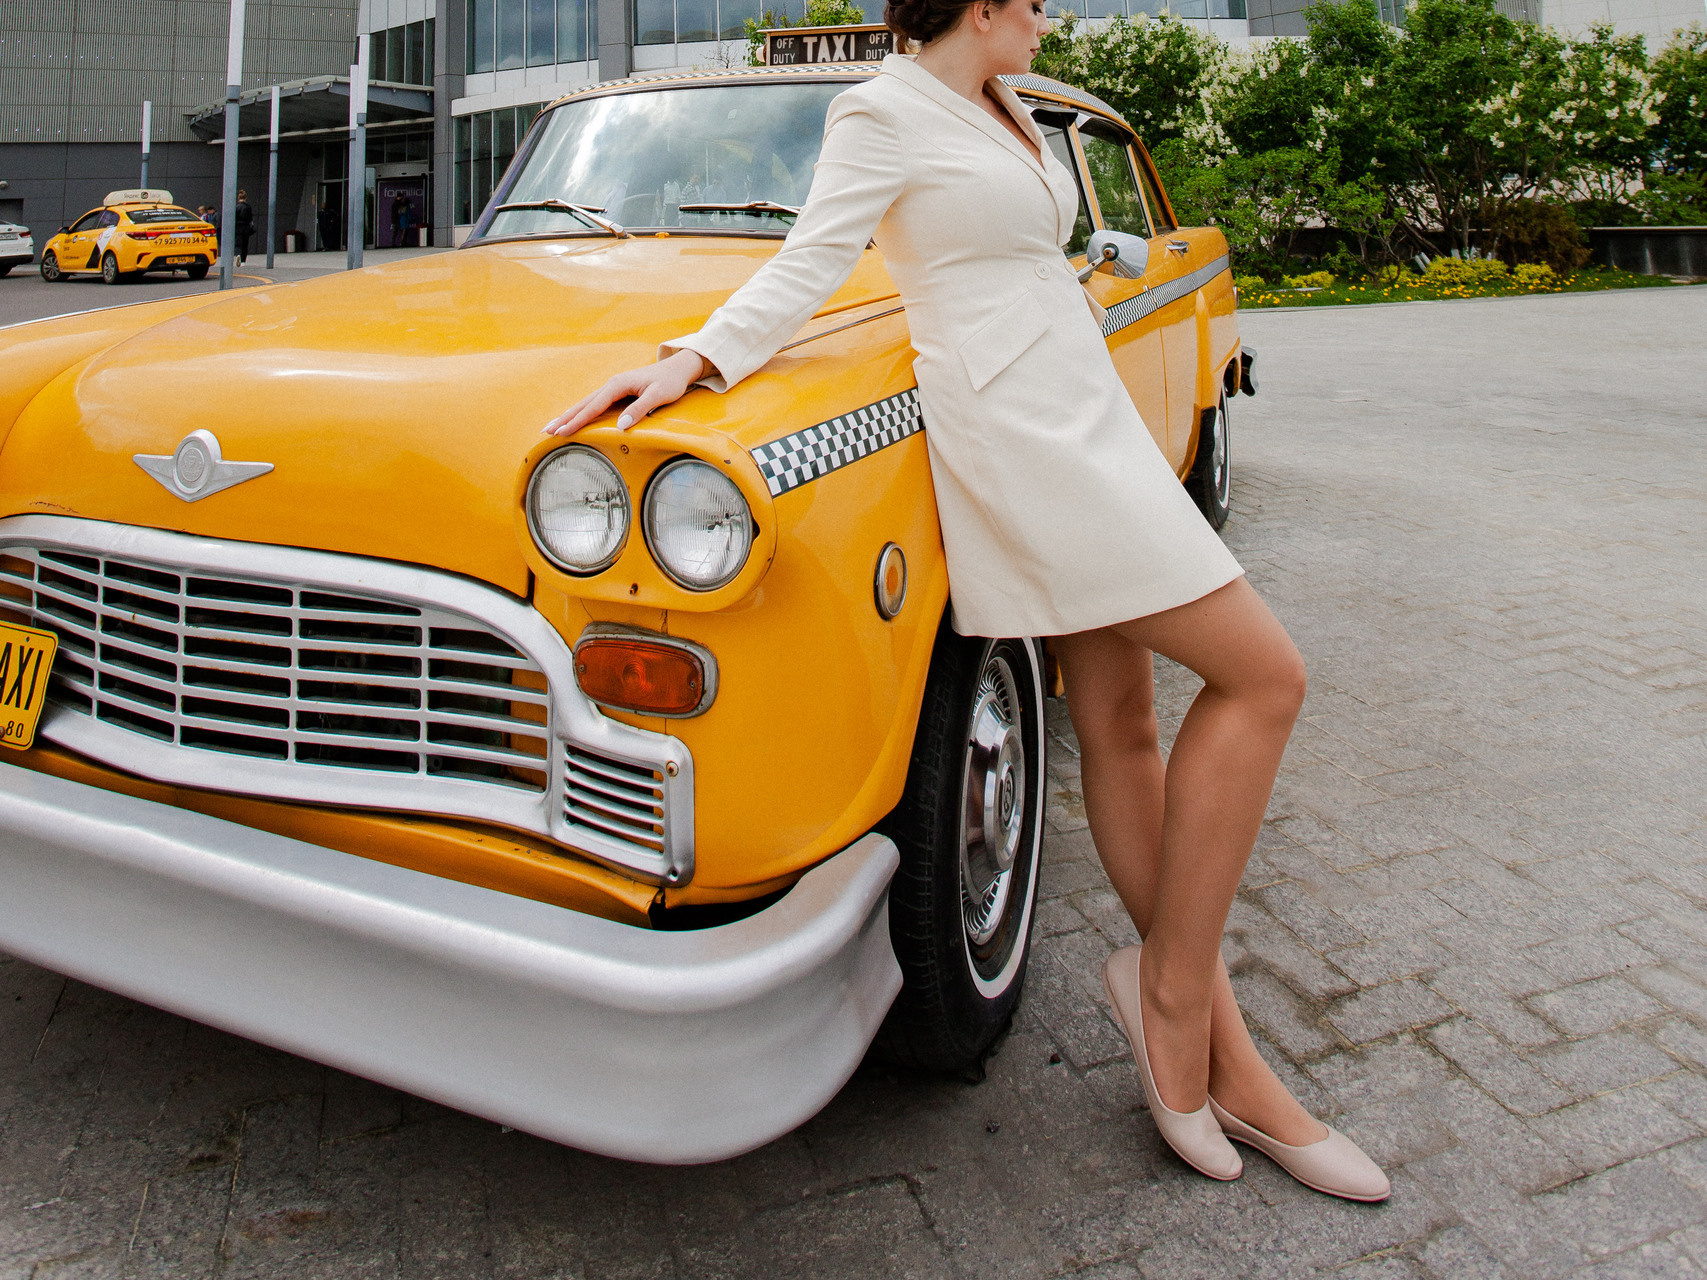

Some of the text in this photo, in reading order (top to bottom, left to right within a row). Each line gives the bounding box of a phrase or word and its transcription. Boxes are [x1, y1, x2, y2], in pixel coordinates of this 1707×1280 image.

[776, 32, 889, 63] OFF TAXI OFF
[773, 53, 796, 64] DUTY
[5, 720, 24, 738] 80
